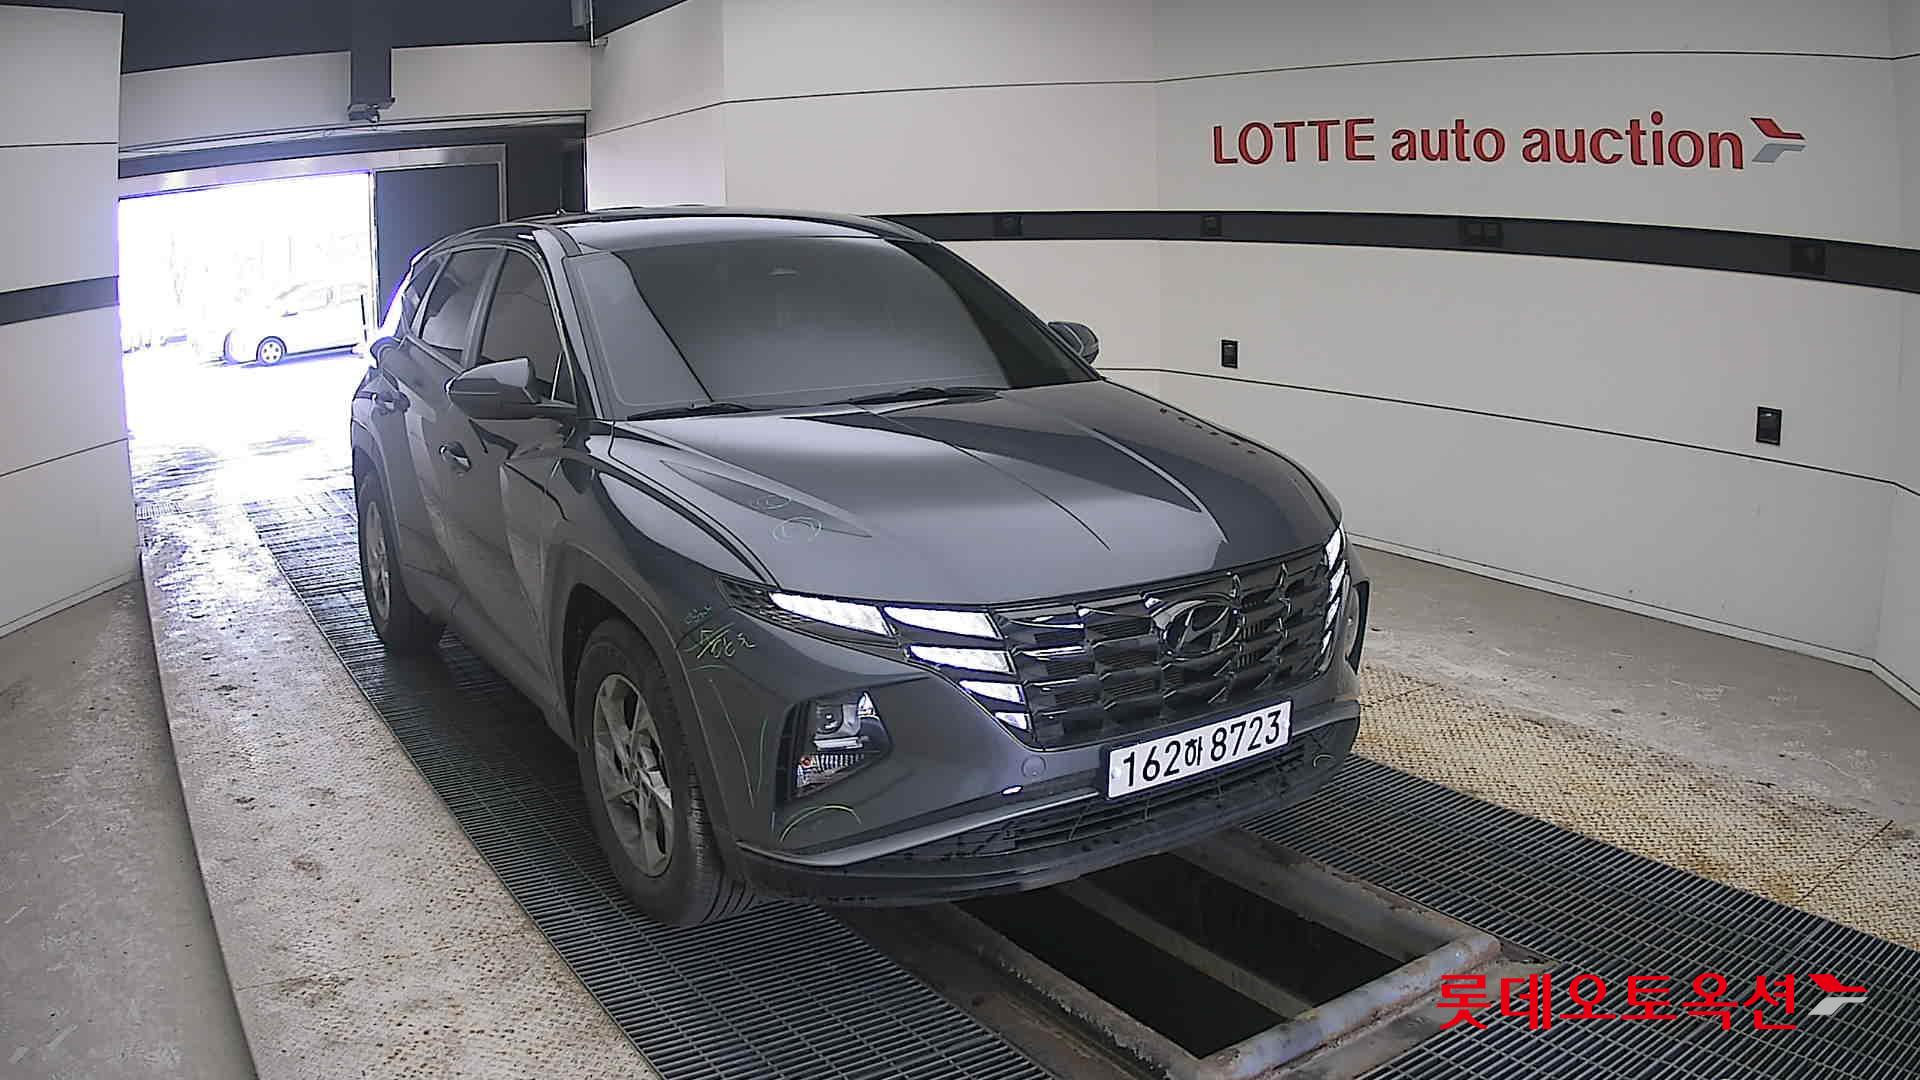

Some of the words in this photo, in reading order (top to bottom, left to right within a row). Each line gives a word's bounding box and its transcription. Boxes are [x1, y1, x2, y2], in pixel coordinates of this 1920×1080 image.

[1212, 118, 1375, 165] LOTTE
[1391, 118, 1506, 163] auto
[1521, 110, 1744, 170] auction
